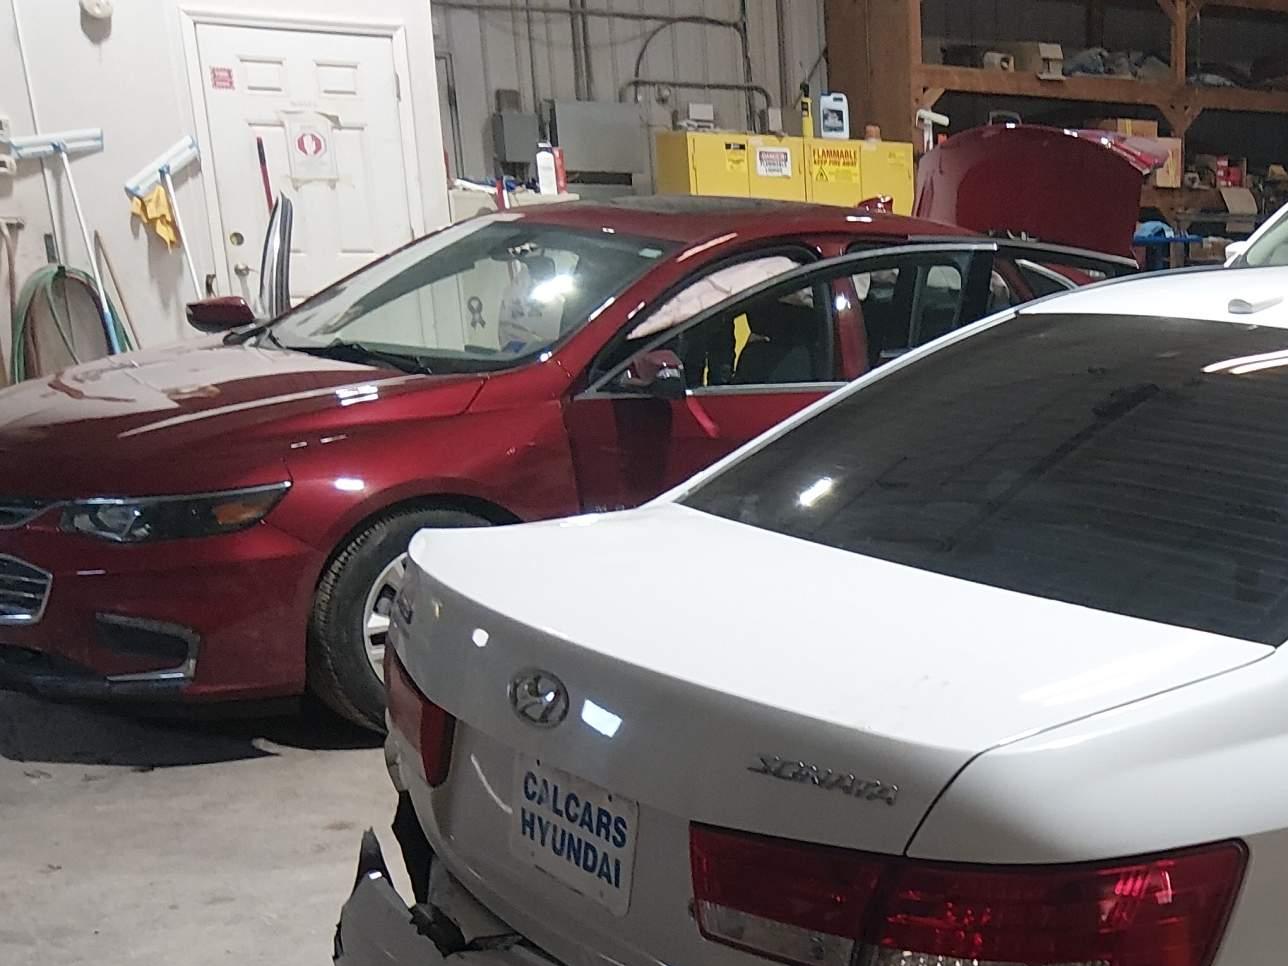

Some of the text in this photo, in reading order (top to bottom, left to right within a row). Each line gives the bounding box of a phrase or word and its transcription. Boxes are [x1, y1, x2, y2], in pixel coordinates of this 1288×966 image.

[813, 148, 857, 160] FLAMMABLE
[521, 807, 621, 889] HYUNDAI
[523, 771, 628, 848] CALCARS
